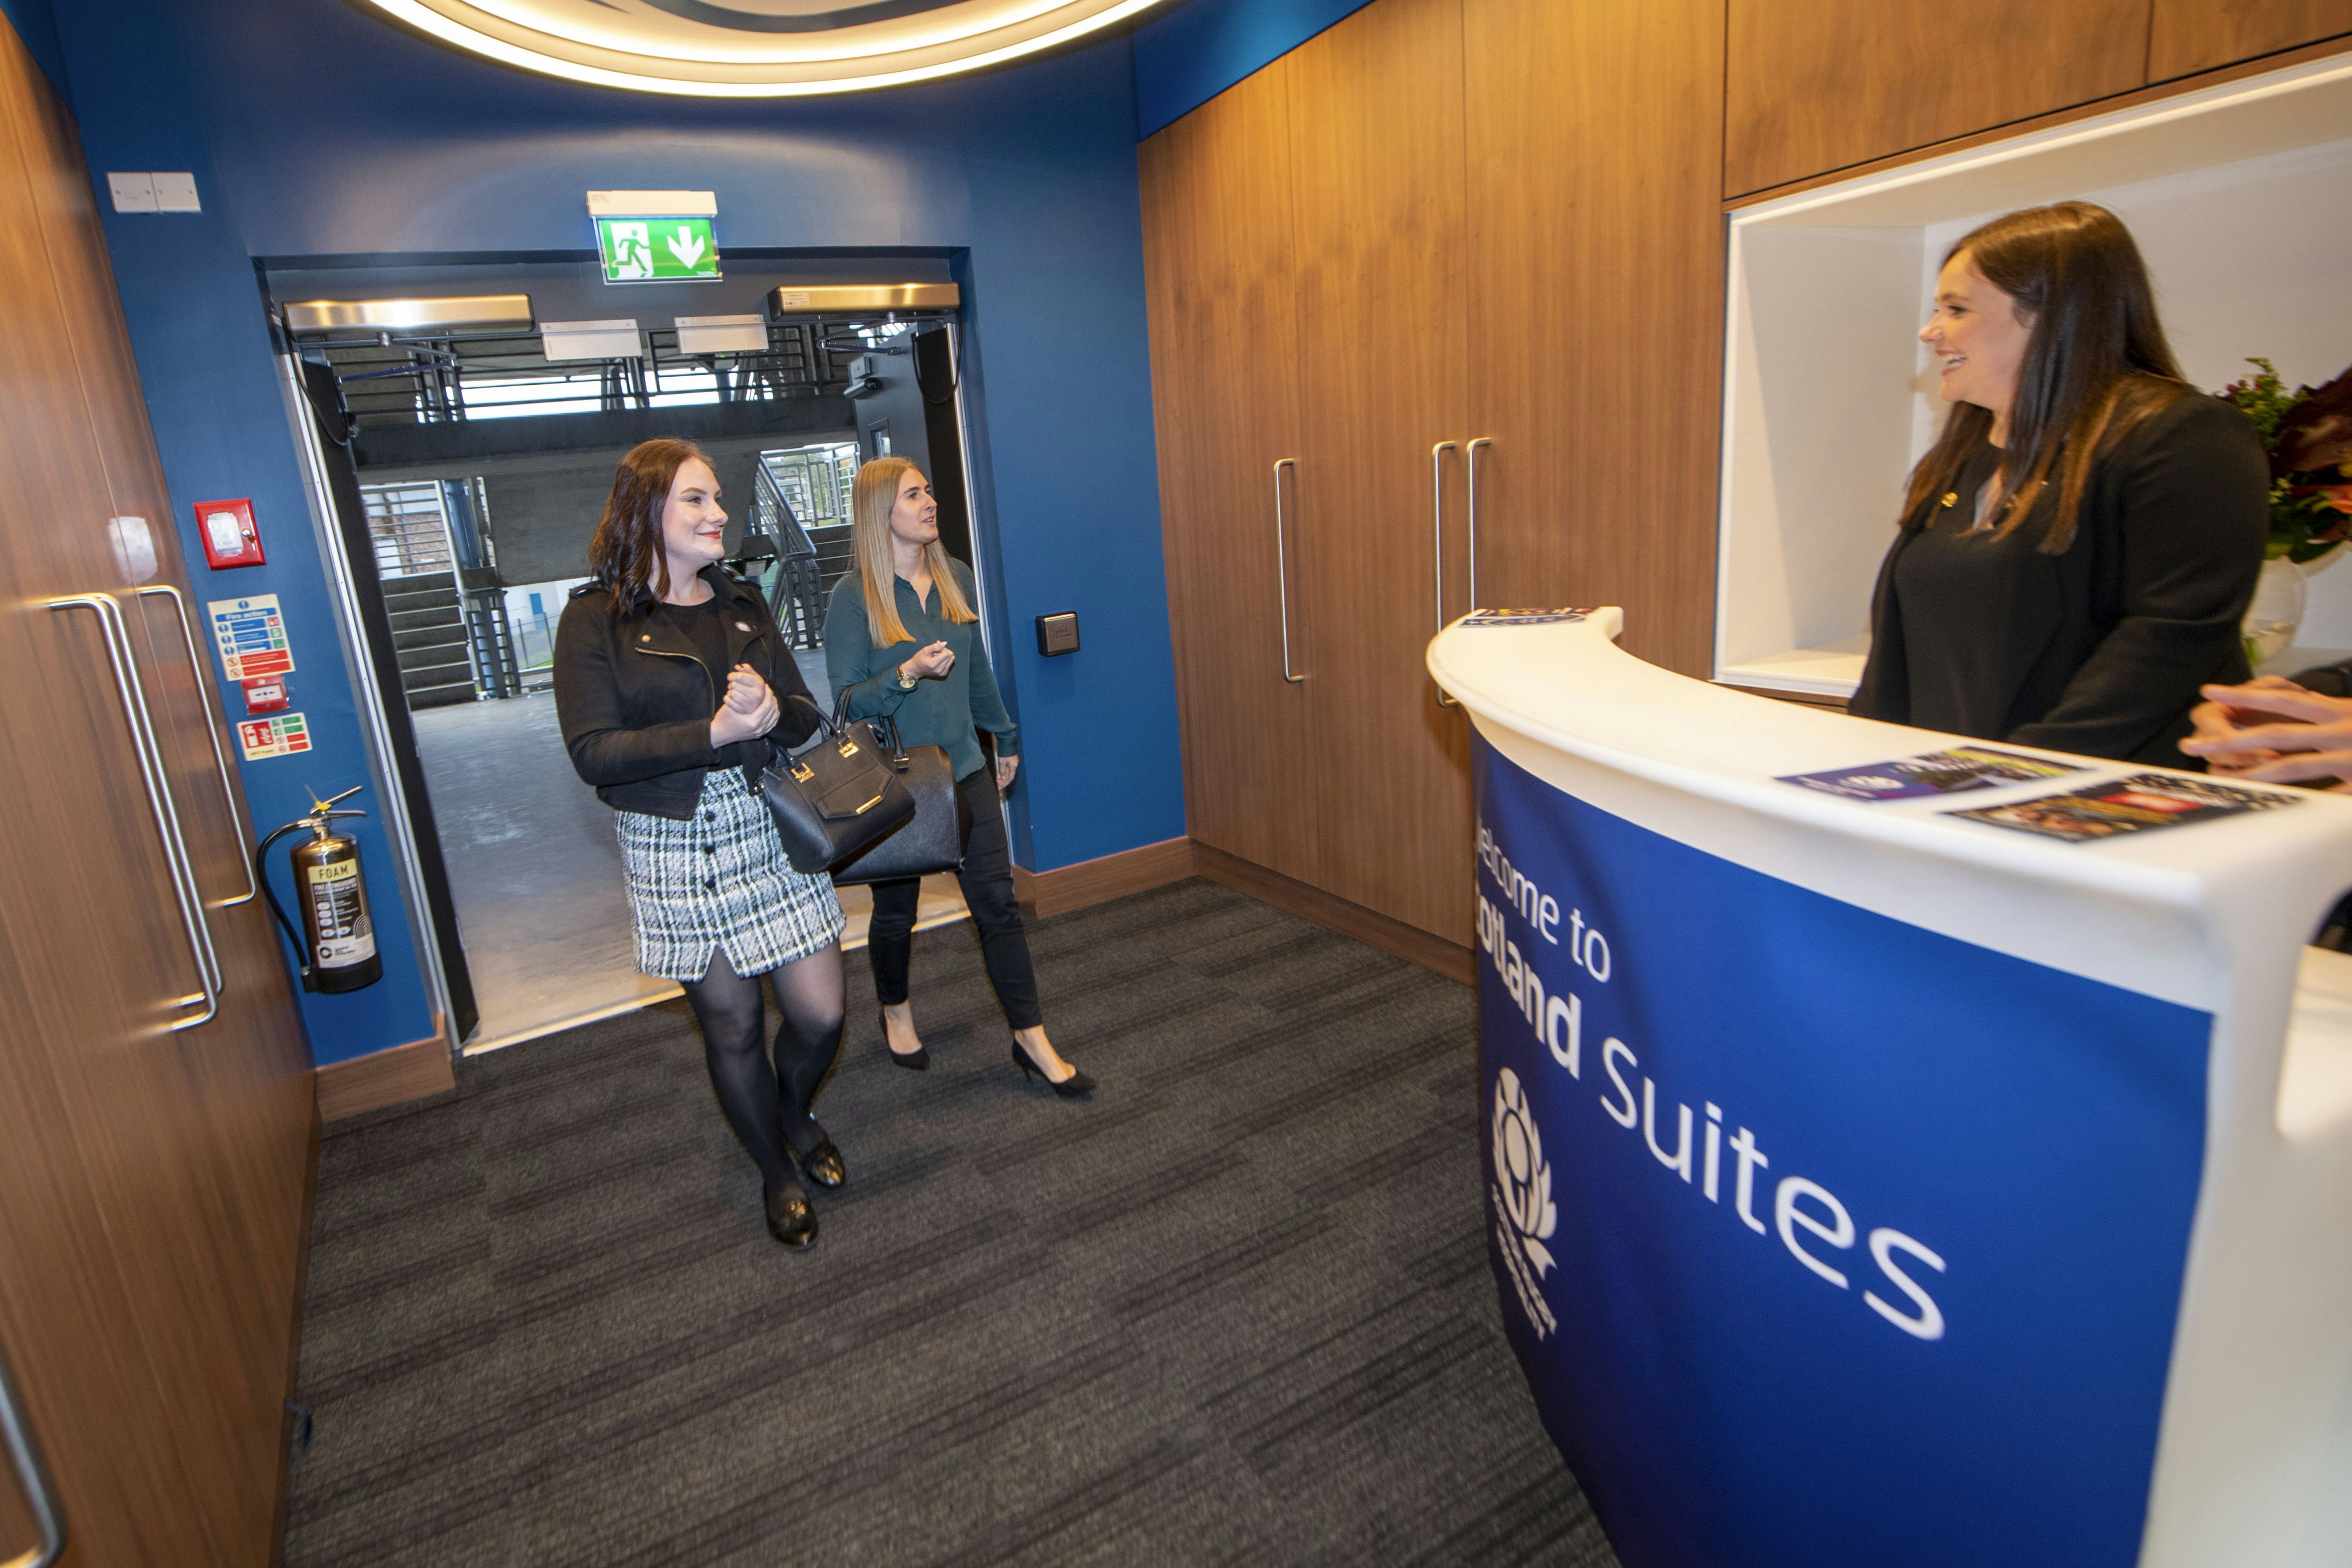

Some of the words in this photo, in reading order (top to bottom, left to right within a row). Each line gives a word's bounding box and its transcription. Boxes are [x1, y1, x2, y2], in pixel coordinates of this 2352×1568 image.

[243, 610, 267, 619] action
[319, 865, 348, 879] FOAM
[1477, 821, 1560, 945] elcome
[1570, 907, 1612, 983] to
[1475, 881, 1581, 1081] otland
[1600, 1037, 1946, 1341] Suites
